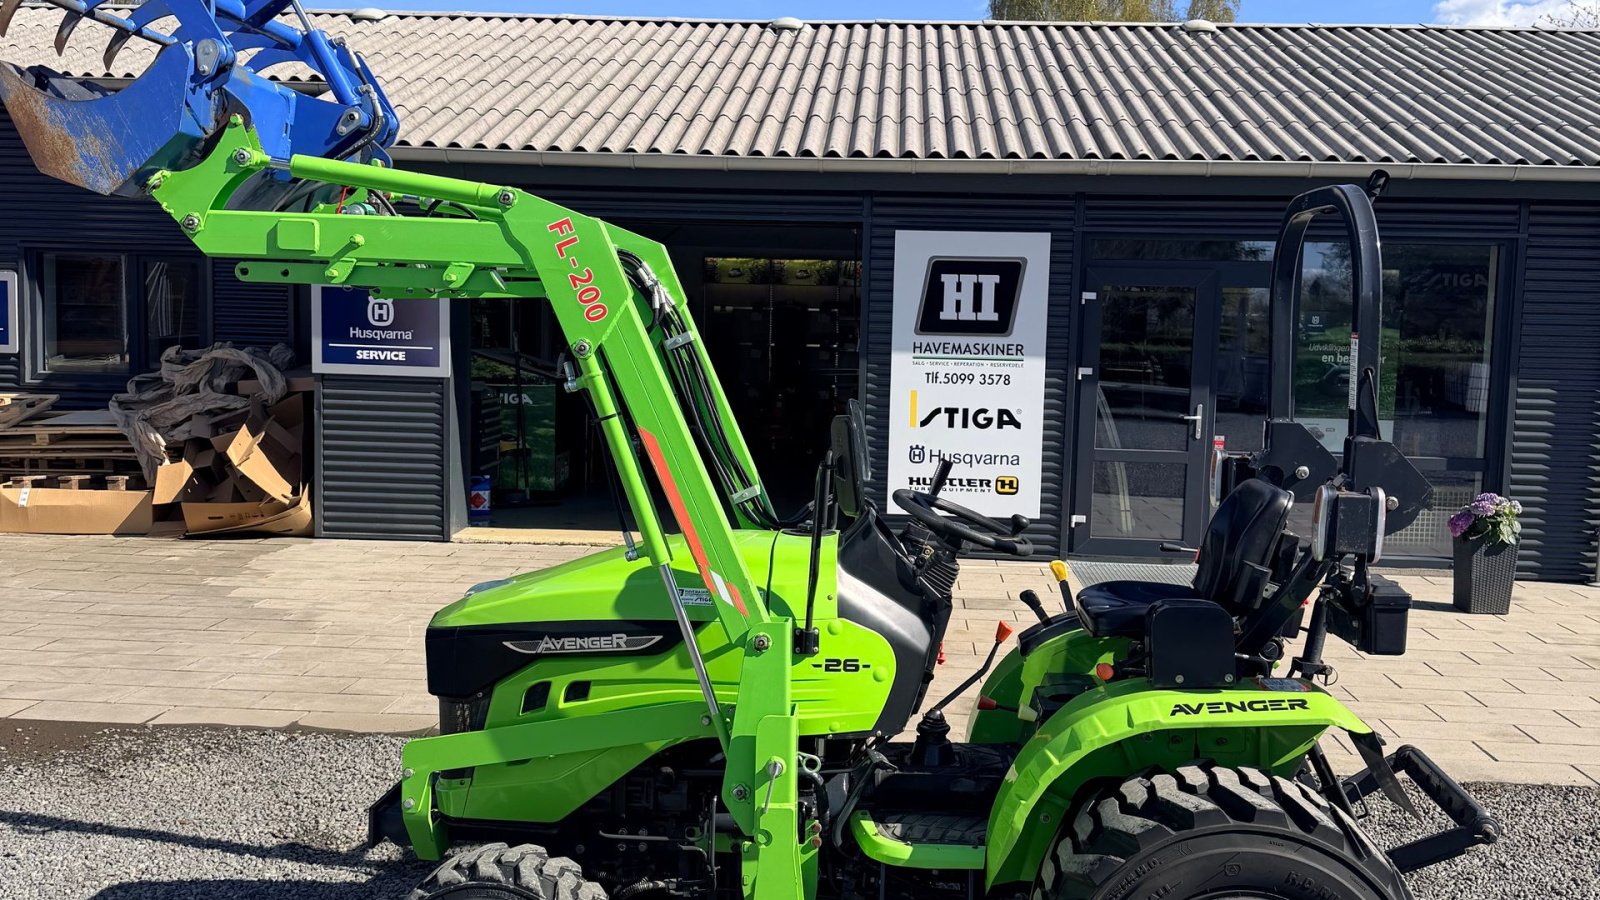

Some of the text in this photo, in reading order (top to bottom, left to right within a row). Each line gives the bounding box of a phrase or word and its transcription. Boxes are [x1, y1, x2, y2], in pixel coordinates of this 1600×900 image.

[547, 217, 608, 322] FL-200
[940, 273, 1000, 321] HI
[349, 326, 412, 341] Husqvarna
[356, 350, 406, 361] SERVICE
[913, 342, 1024, 356] HAVEMASKINER
[1321, 354, 1334, 363] en
[925, 371, 1011, 386] Tlf.5099 3578
[919, 407, 1021, 430] STIGA
[929, 449, 1021, 468] Husqvarna
[908, 477, 992, 488] HUTLER
[537, 633, 627, 652] AVENGER
[1170, 698, 1310, 717] AVENGER
